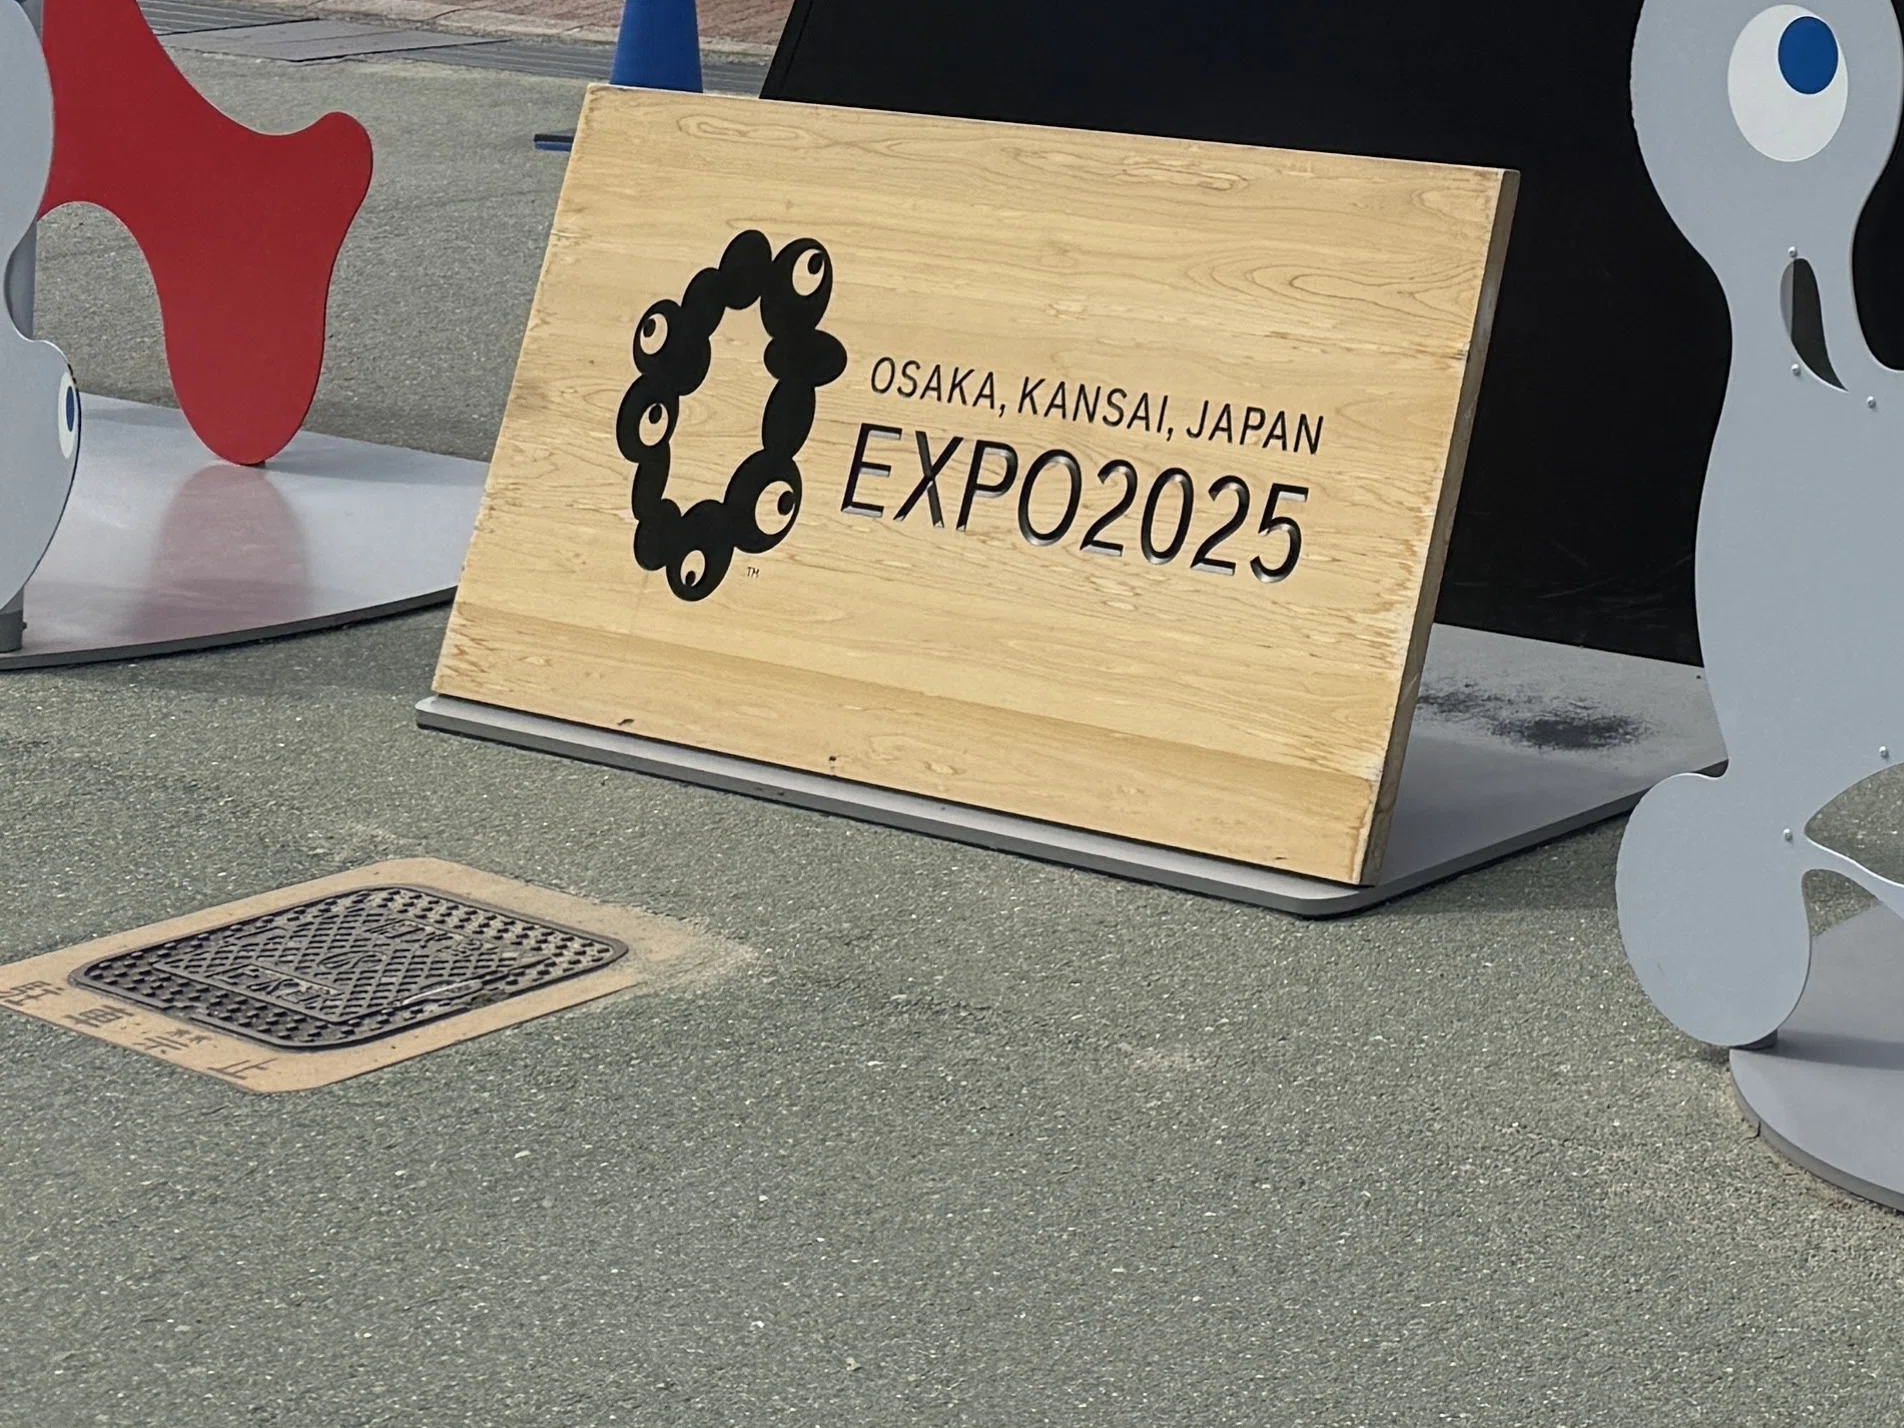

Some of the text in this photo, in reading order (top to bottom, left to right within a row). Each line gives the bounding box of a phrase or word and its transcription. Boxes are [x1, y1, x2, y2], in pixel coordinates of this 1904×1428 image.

[870, 357, 1324, 455] OSAKA, KANSAI, JAPAN
[841, 423, 1309, 583] EXPO2025
